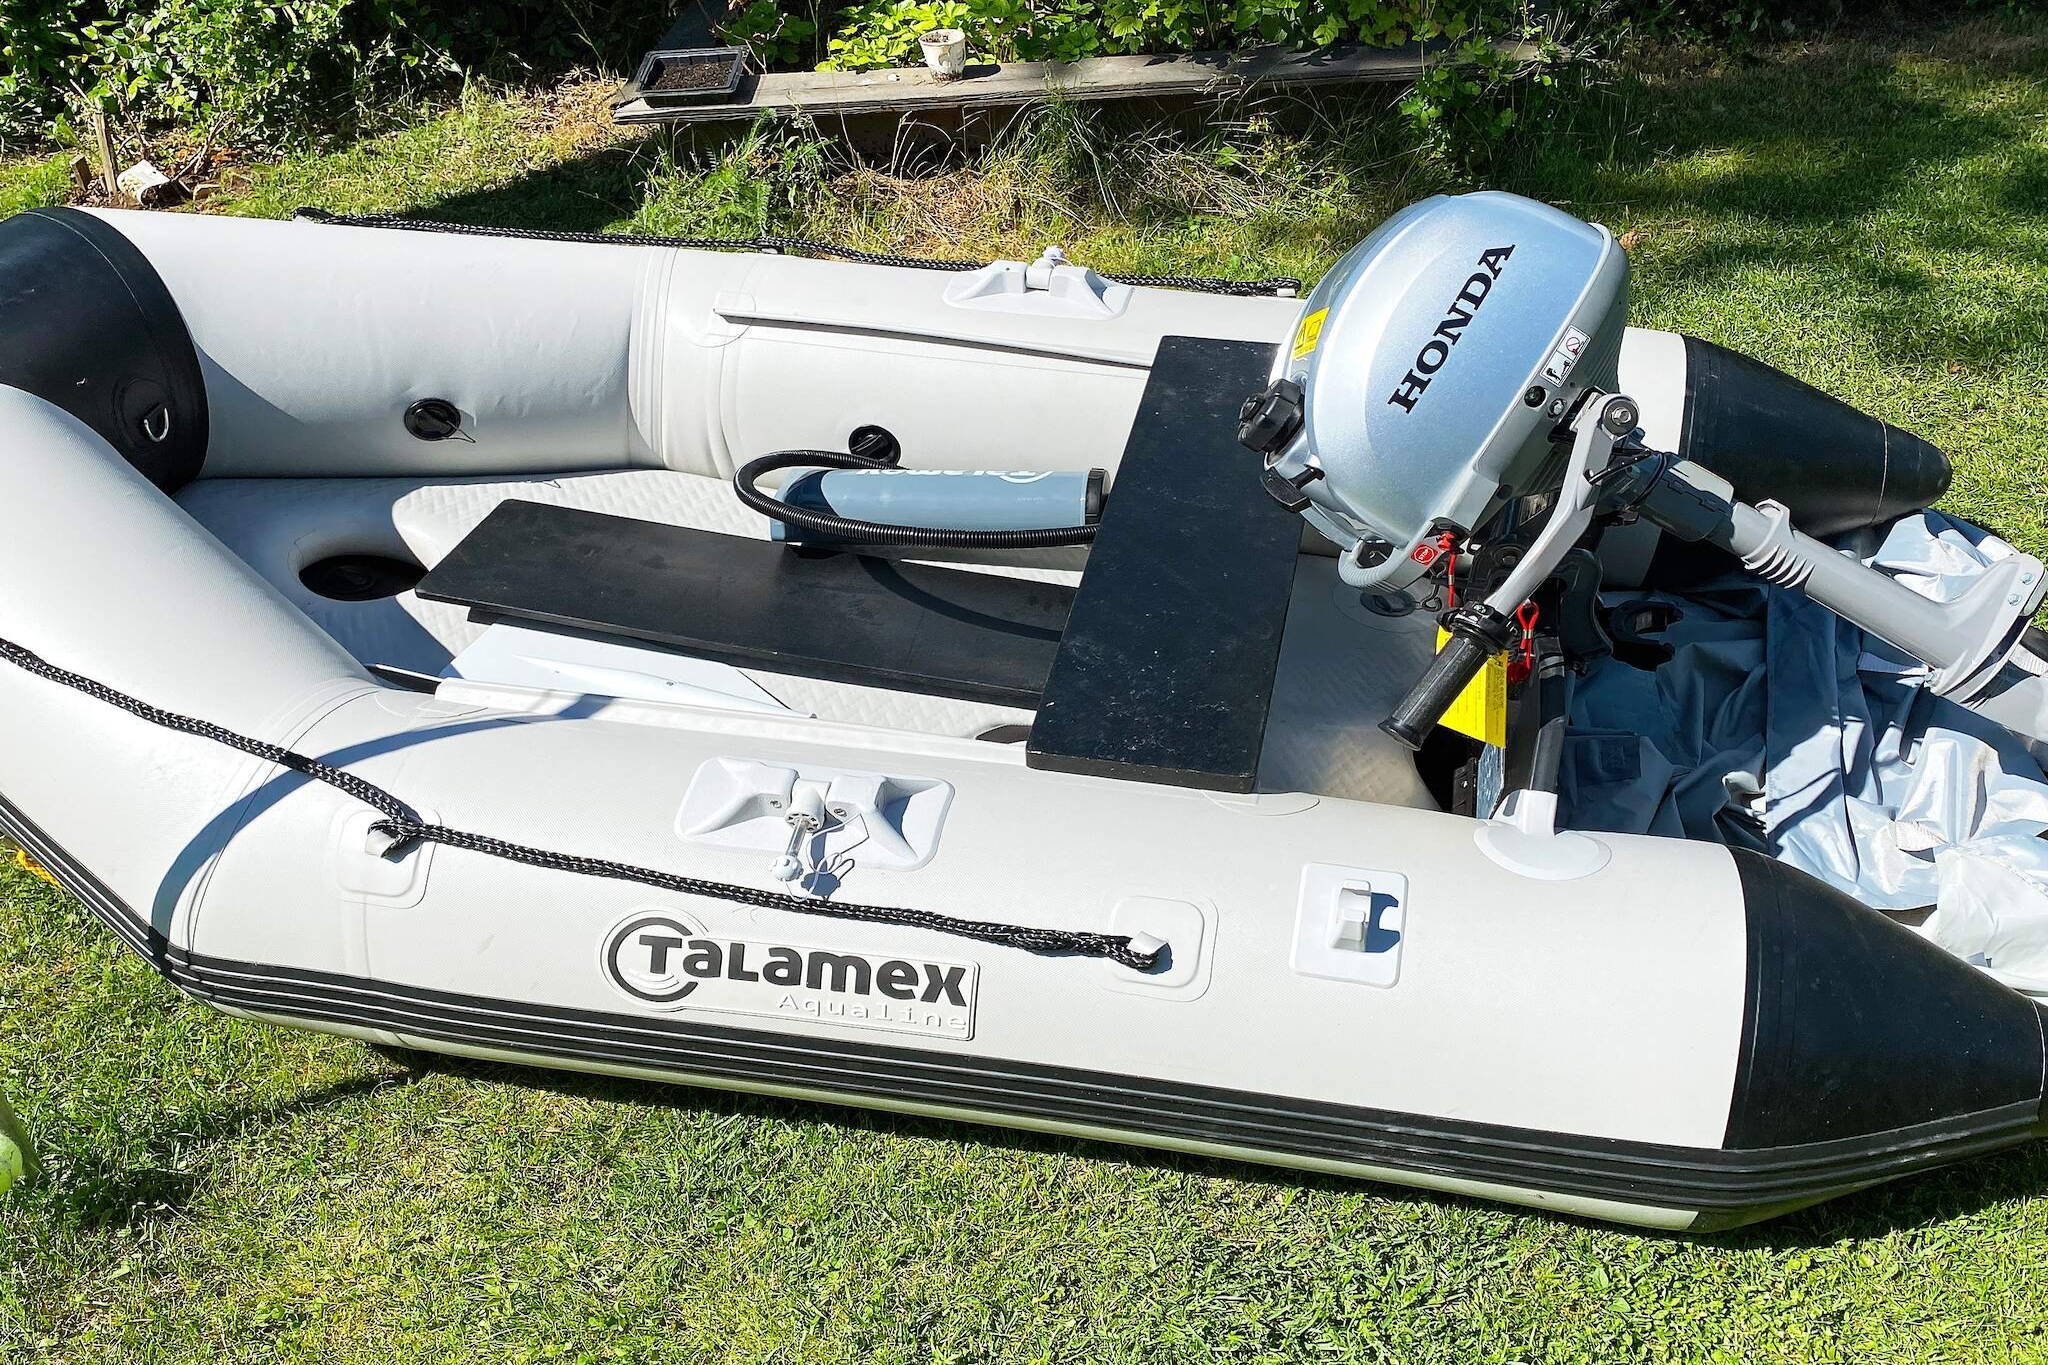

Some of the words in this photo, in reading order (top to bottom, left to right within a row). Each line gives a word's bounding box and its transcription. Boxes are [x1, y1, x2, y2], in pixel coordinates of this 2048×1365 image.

[1387, 244, 1516, 414] HONDA
[1418, 549, 1428, 560] STOP
[775, 991, 967, 1031] Aqualine
